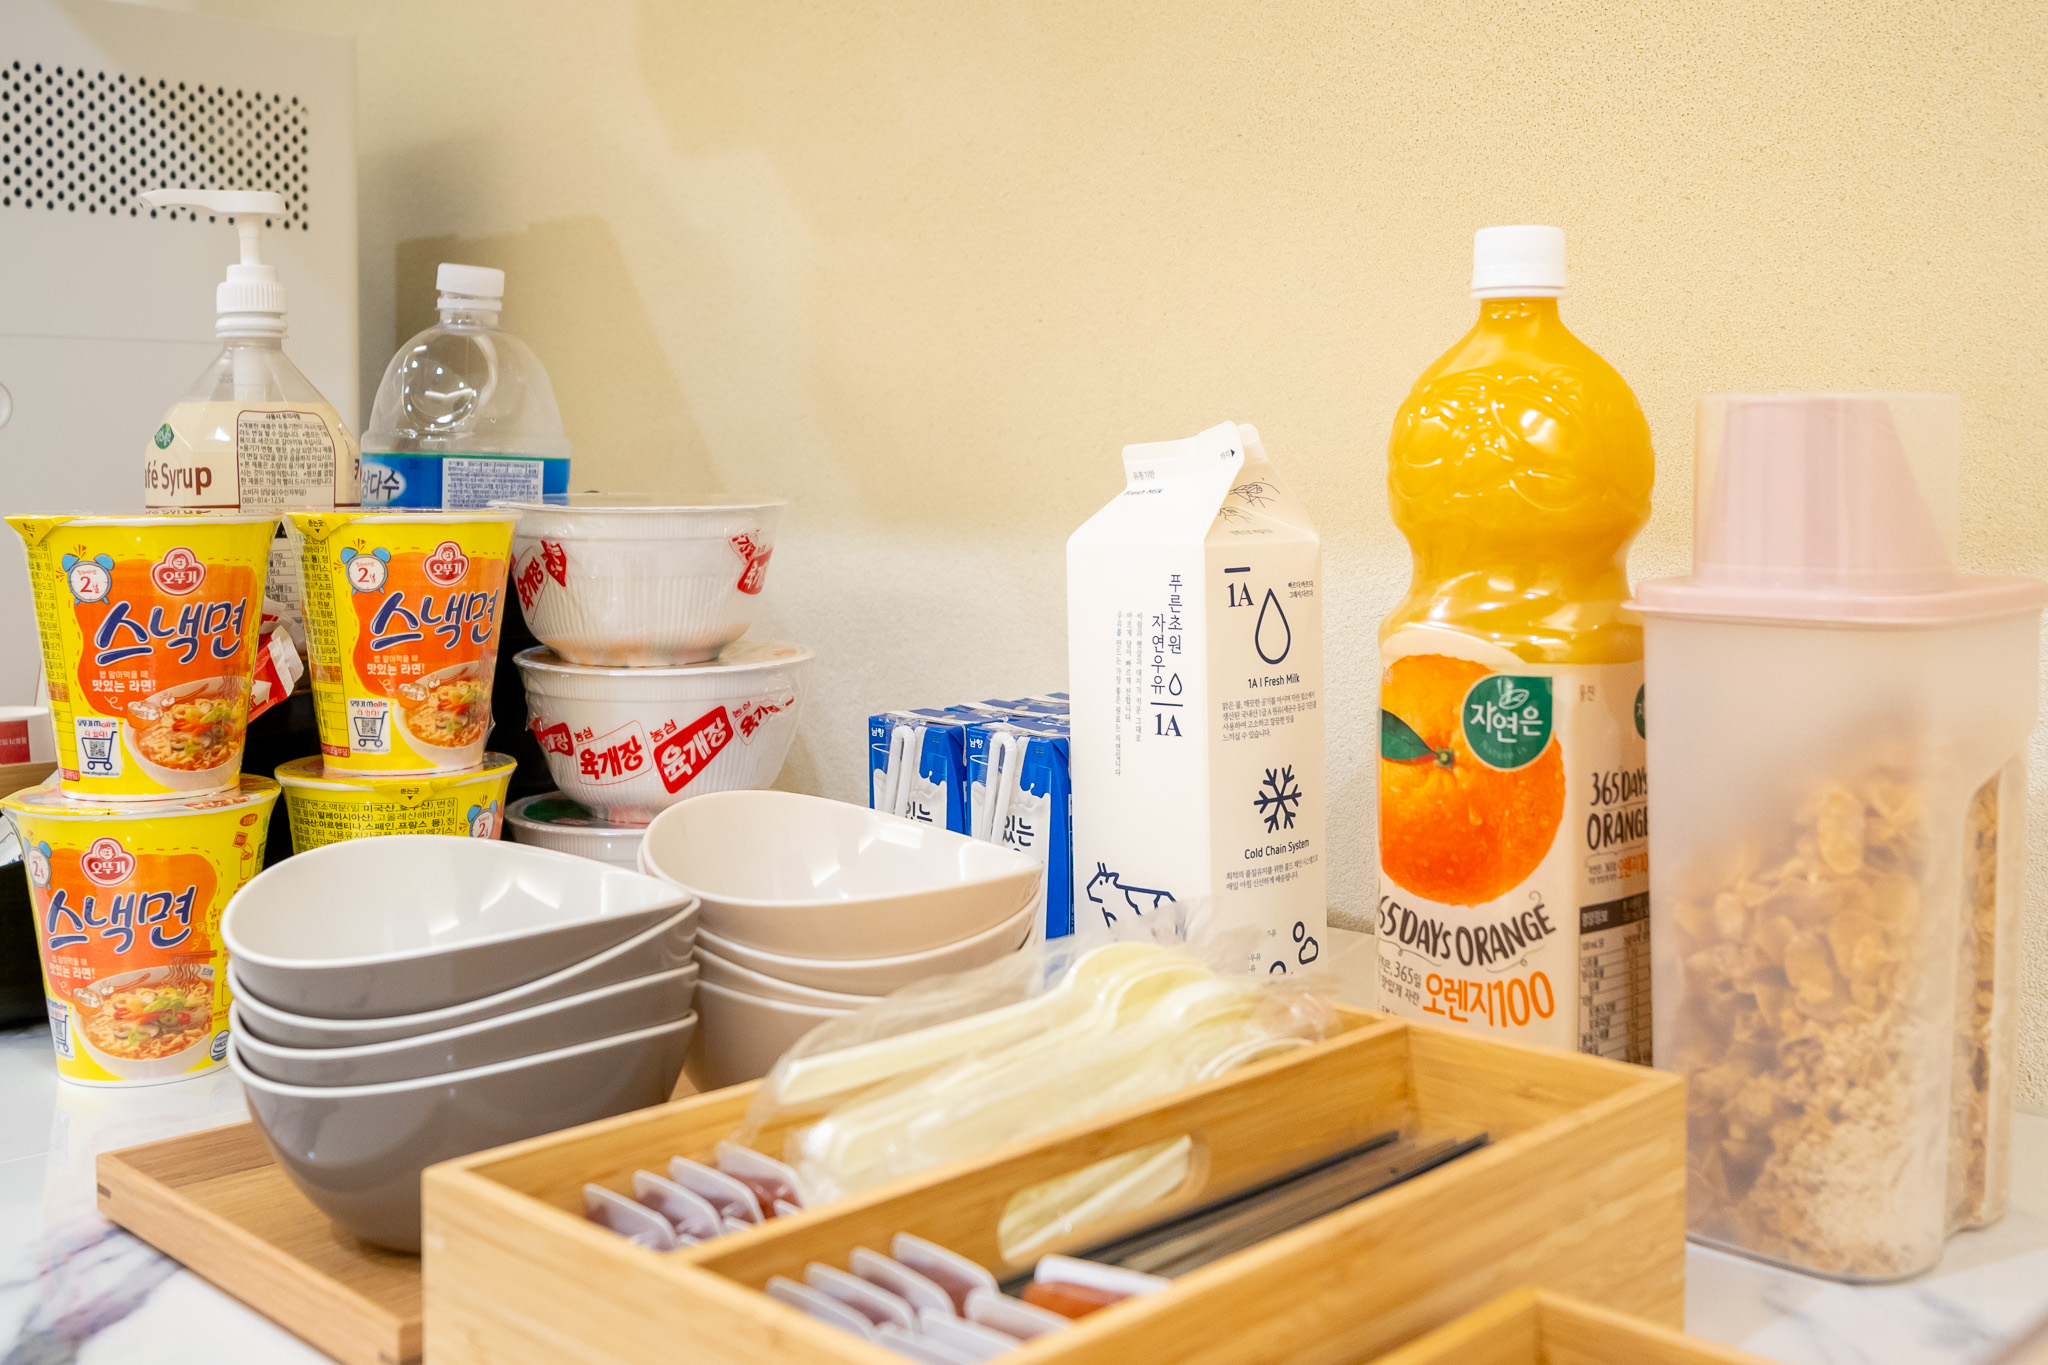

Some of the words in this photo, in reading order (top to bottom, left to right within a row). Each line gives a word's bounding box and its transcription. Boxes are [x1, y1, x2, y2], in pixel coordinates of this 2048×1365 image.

[161, 462, 212, 496] Syrup
[162, 570, 197, 584] 오뚜기
[432, 562, 463, 576] 오뚜기
[1227, 582, 1254, 608] 1A
[369, 588, 499, 650] 스낵면
[1168, 574, 1183, 654] 푸른초원
[95, 598, 247, 665] 스낵면
[1151, 613, 1166, 694] 자연우유
[367, 664, 397, 676] 맛있는
[400, 664, 425, 675] 라면!
[1248, 678, 1258, 688] 1A
[1264, 676, 1285, 686] Fresh
[1286, 674, 1300, 684] Milk
[92, 680, 125, 692] 맛있는
[129, 680, 156, 692] 라면!
[1154, 713, 1183, 737] 1A
[1241, 709, 1258, 719] 국내산
[1470, 701, 1543, 743] 자연은
[574, 727, 594, 742] 농심
[649, 718, 678, 742] 농심
[871, 728, 884, 738] 남양
[662, 716, 727, 782] 육개장
[970, 738, 983, 749] 남양
[580, 735, 643, 781] 육개장
[1590, 770, 1619, 806] 365
[1244, 848, 1263, 859] Cold
[1266, 844, 1286, 856] Chain
[1288, 839, 1310, 854] System
[90, 862, 126, 875] 오뚜기
[46, 884, 197, 954] 스낵면
[1399, 907, 1452, 959] DAYS
[1456, 904, 1556, 967] ORANGE
[73, 967, 96, 980] 라면!
[1422, 970, 1555, 1028] 오렌지100
